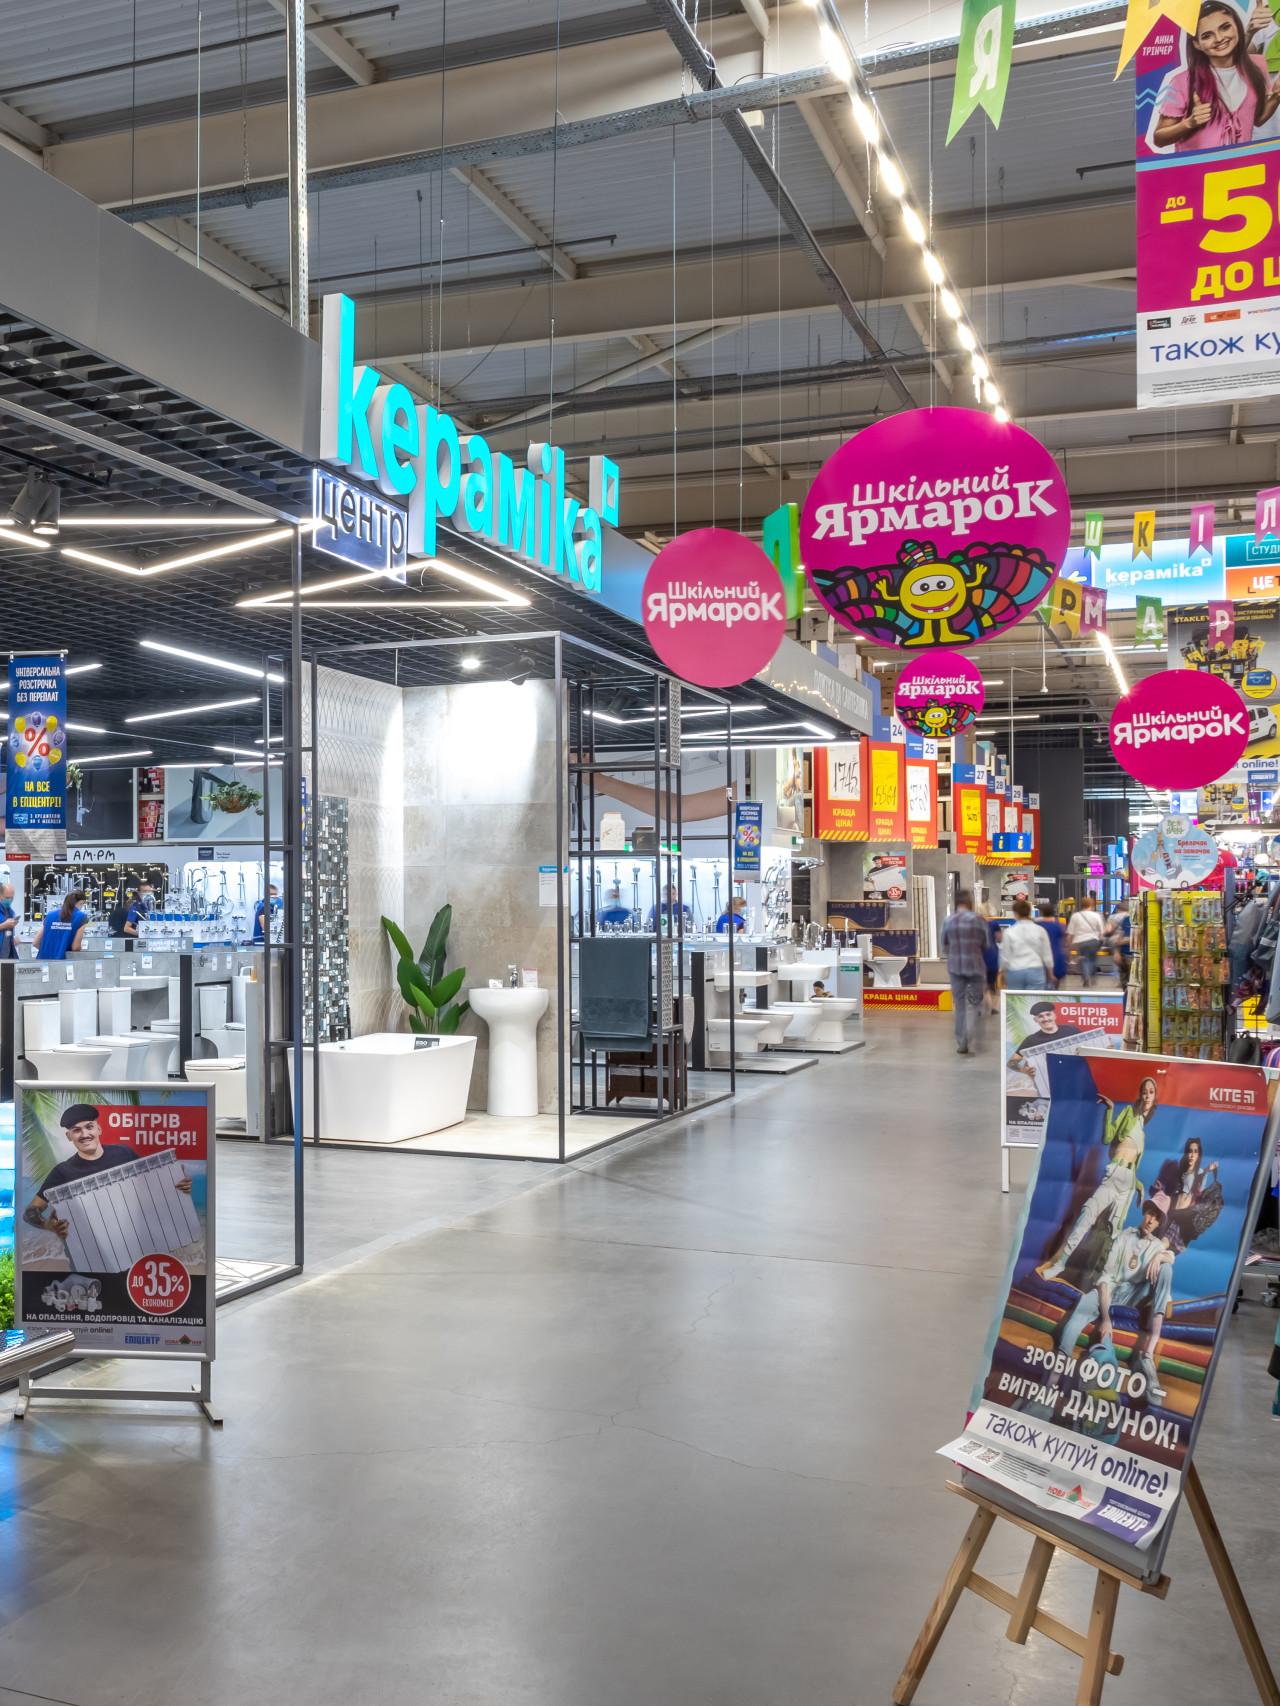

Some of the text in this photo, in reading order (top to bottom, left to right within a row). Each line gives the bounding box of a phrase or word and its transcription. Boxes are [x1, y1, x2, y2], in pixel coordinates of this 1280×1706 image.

[1154, 35, 1174, 44] АННА
[969, 5, 1002, 97] Я
[1142, 45, 1173, 57] ТРІНЧЕР
[1150, 335, 1244, 362] також
[853, 466, 1010, 507] Шкільний
[318, 477, 404, 556] центр
[667, 580, 760, 601] Шкільний
[1085, 595, 1103, 627] М
[16, 666, 60, 677] УНІВЕРСАЛЬНА
[912, 675, 966, 685] Шкільний
[17, 691, 59, 702] БЕЗ ПЕРЕПЛАТ
[1132, 706, 1222, 727] Шкільний
[892, 725, 903, 737] 24
[925, 743, 935, 754] 25
[1242, 759, 1279, 769] online!
[976, 771, 985, 780] 27
[24, 781, 50, 792] НА ВСЕ
[996, 779, 1004, 789] 28
[20, 796, 61, 808] ЕПІЦЕНТРІ!
[832, 808, 856, 817] КРАЩА
[863, 993, 893, 1001] КРАЩА
[1060, 1006, 1108, 1016] ОБІГРІВ
[1077, 1016, 1119, 1026] ПІСНЯ!
[1209, 1087, 1242, 1103] KITE
[108, 1112, 181, 1129] ОБІГРІВ
[135, 1130, 197, 1146] ПІСНЯ!
[38, 1313, 83, 1322] ОПАЛЕННЯ,
[84, 1315, 136, 1323] ВОДОПРОВІД
[137, 1316, 147, 1324] ТА
[148, 1316, 203, 1325] КАНАЛІЗАЦІЮ
[90, 1325, 114, 1334] online!
[124, 1335, 161, 1345] ЕПІЦЕНТР
[1023, 1345, 1076, 1378] ЗРОБИ
[1078, 1356, 1148, 1399] ФОТО
[1060, 1390, 1180, 1451] ДАРУНОК!
[984, 1412, 1042, 1449] також
[1042, 1434, 1099, 1472] купуй
[1100, 1456, 1170, 1498] online!
[1047, 1486, 1066, 1498] НОВА
